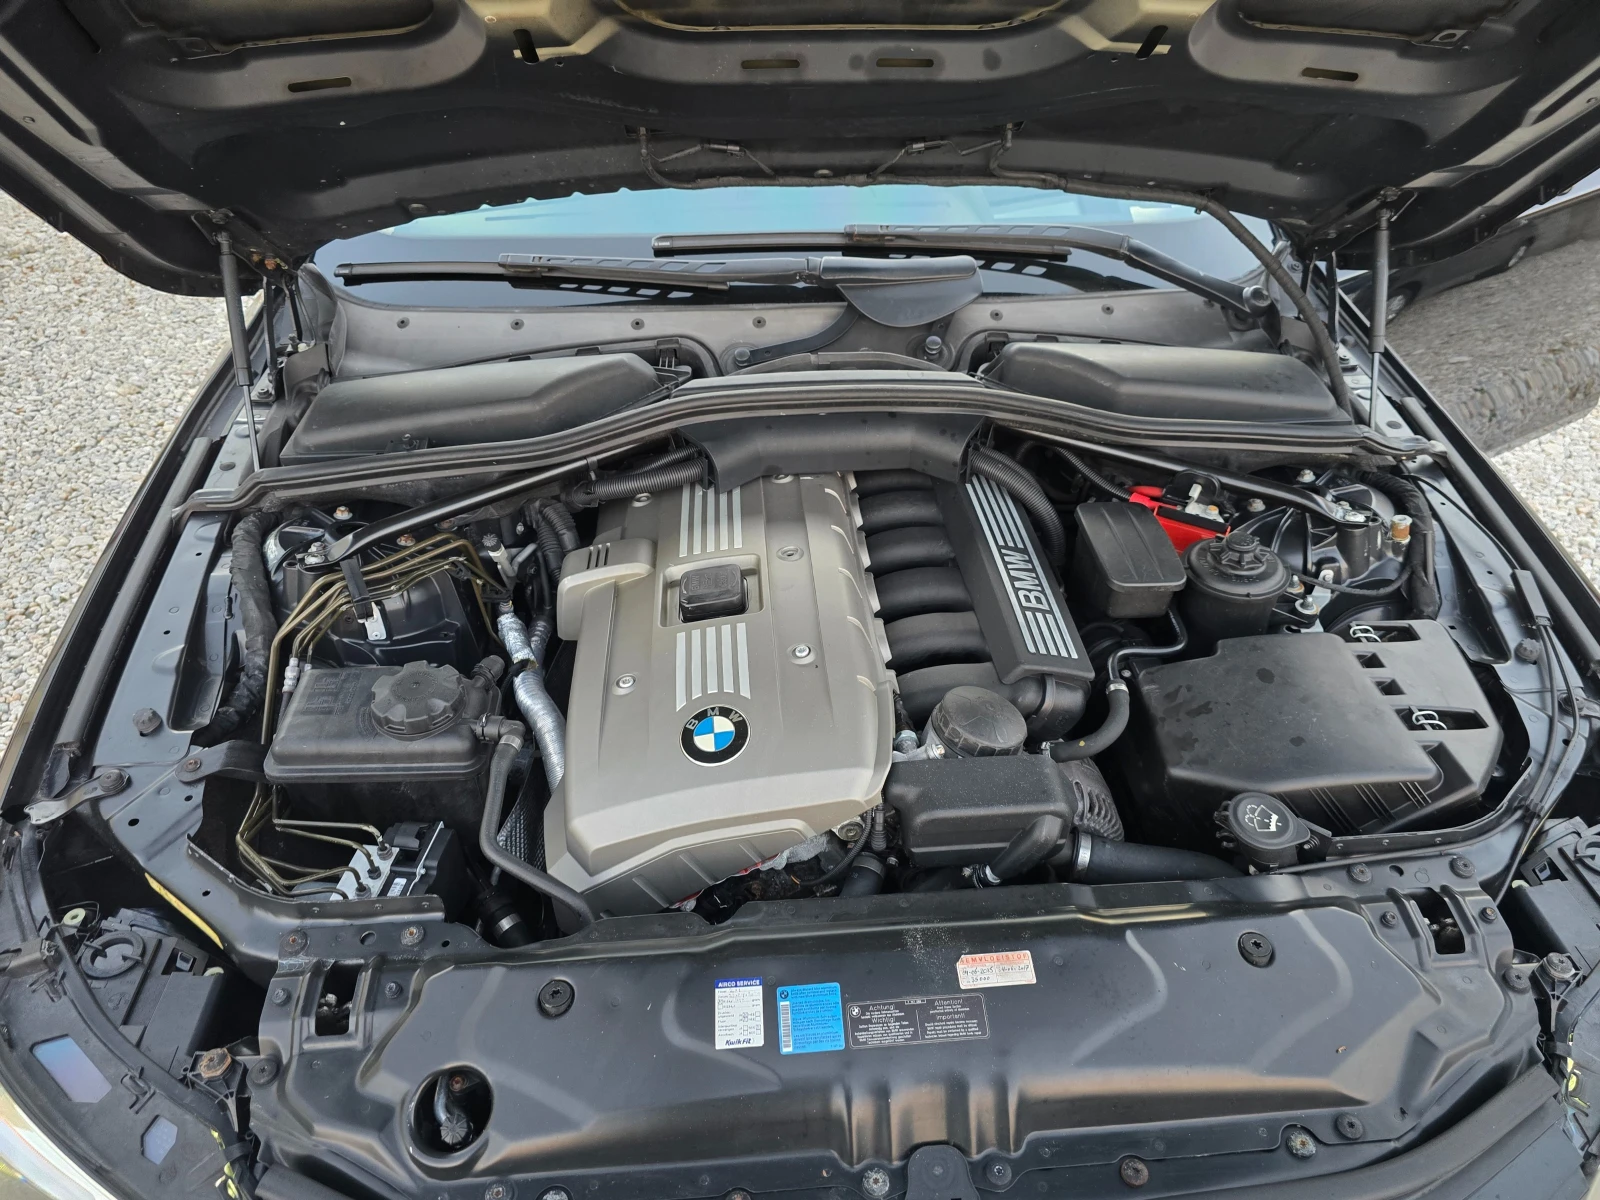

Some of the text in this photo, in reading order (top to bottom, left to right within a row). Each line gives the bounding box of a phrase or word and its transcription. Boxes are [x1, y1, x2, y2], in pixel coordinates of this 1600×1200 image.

[1001, 549, 1050, 611] BMW
[685, 706, 743, 730] BMW
[737, 979, 760, 987] SERVICE
